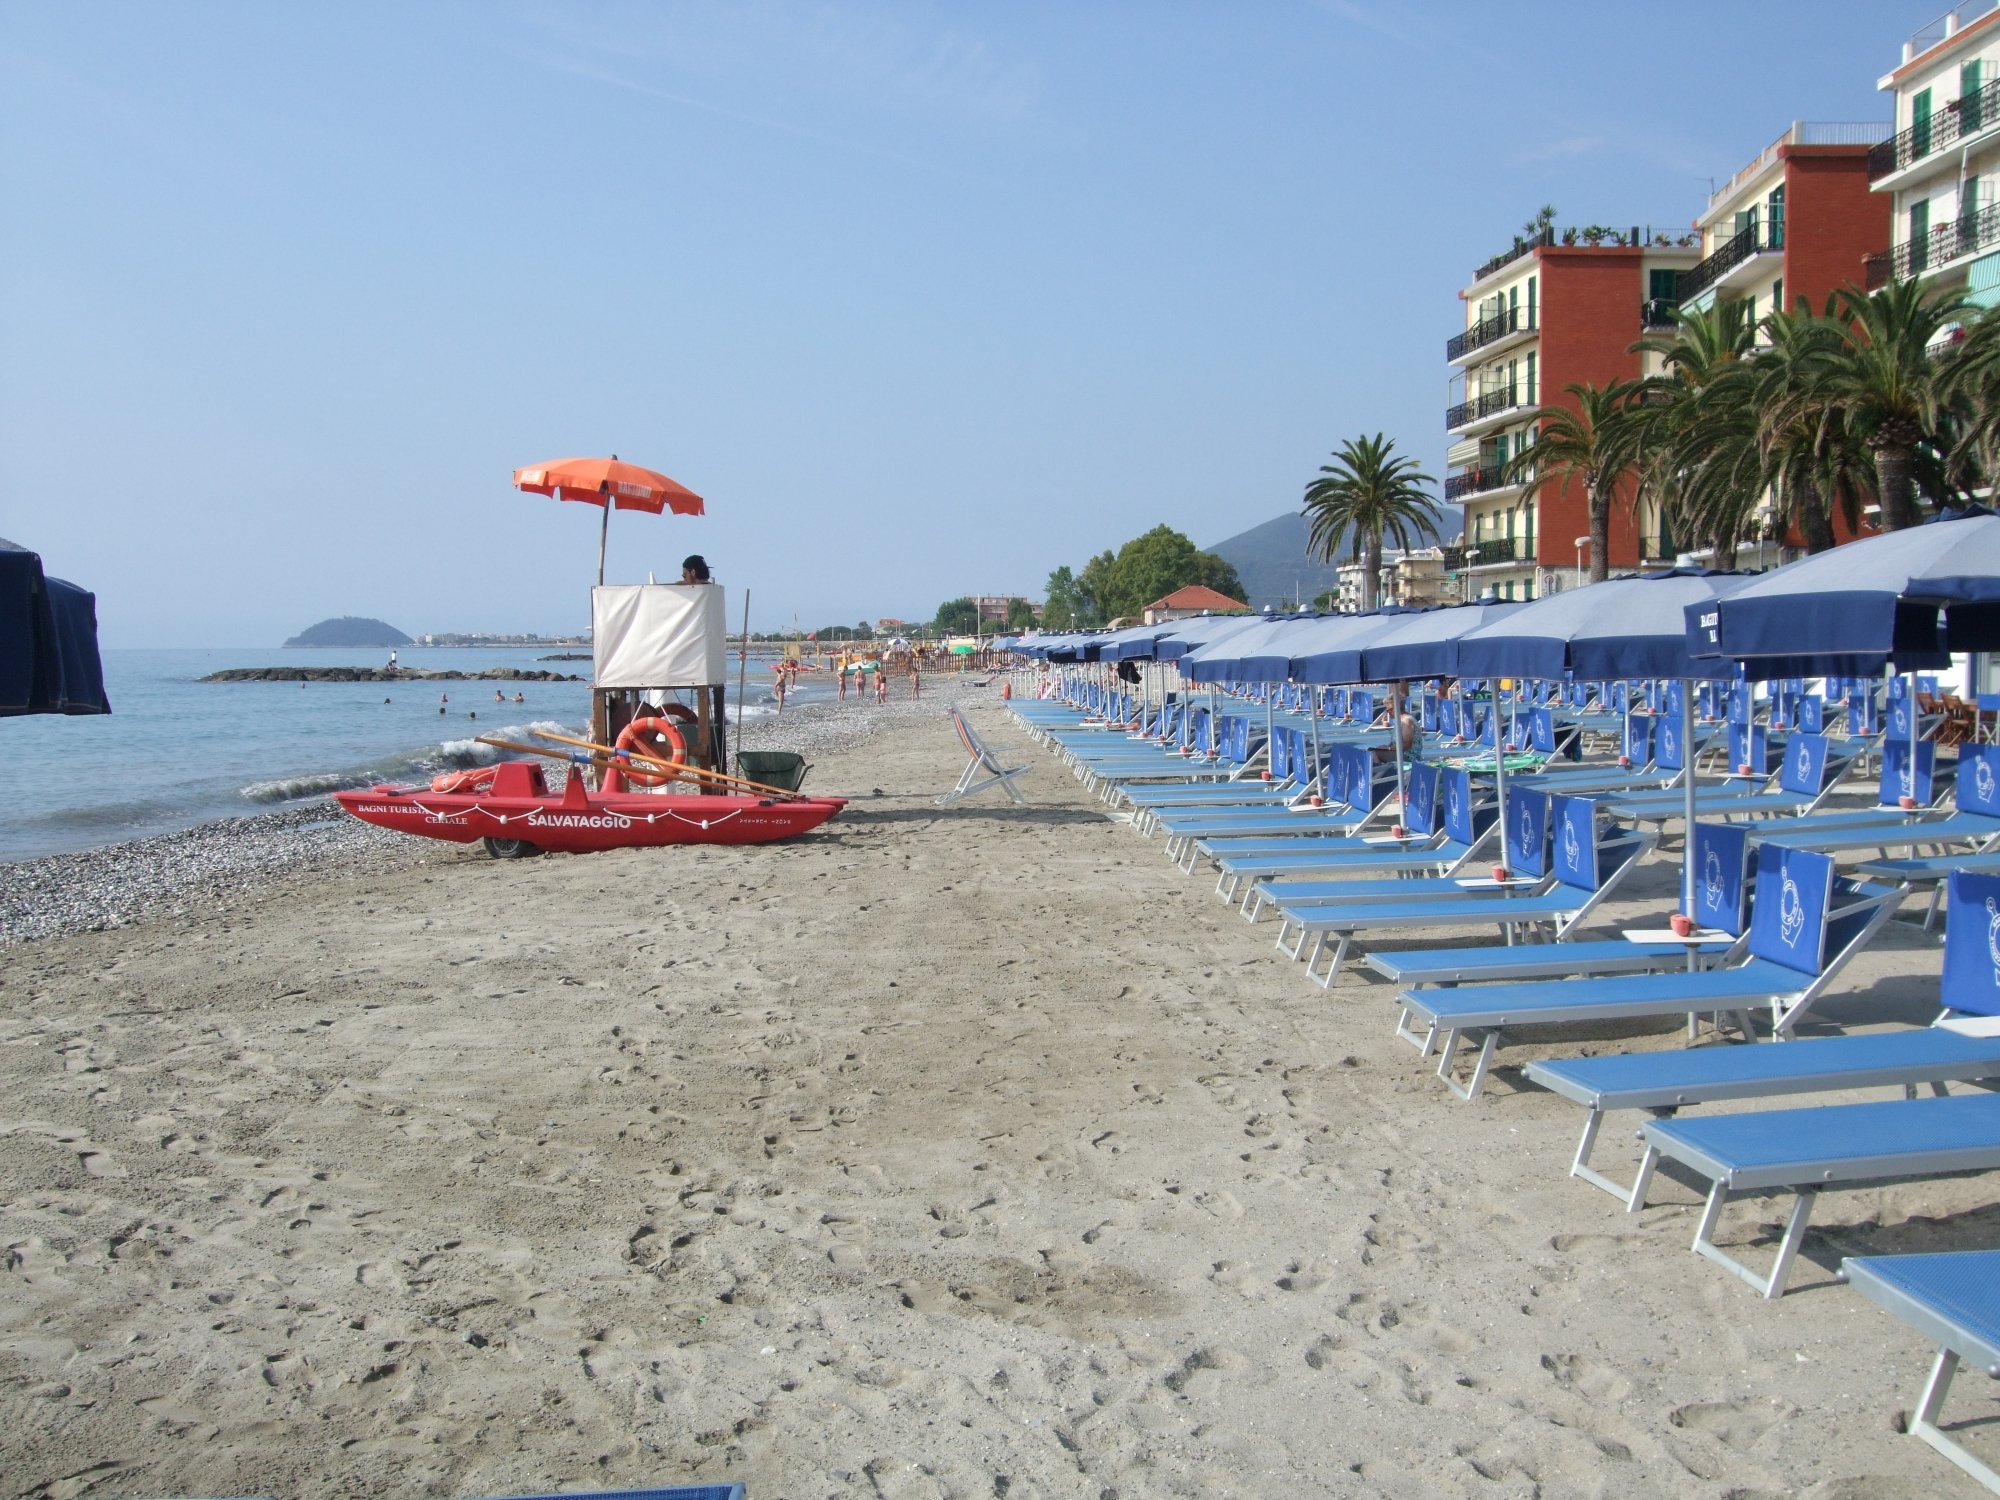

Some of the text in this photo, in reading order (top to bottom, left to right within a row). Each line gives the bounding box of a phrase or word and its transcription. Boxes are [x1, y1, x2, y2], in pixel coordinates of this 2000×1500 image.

[358, 804, 429, 815] BAGNI TURISTA
[527, 814, 631, 829] SALVATAGGIO
